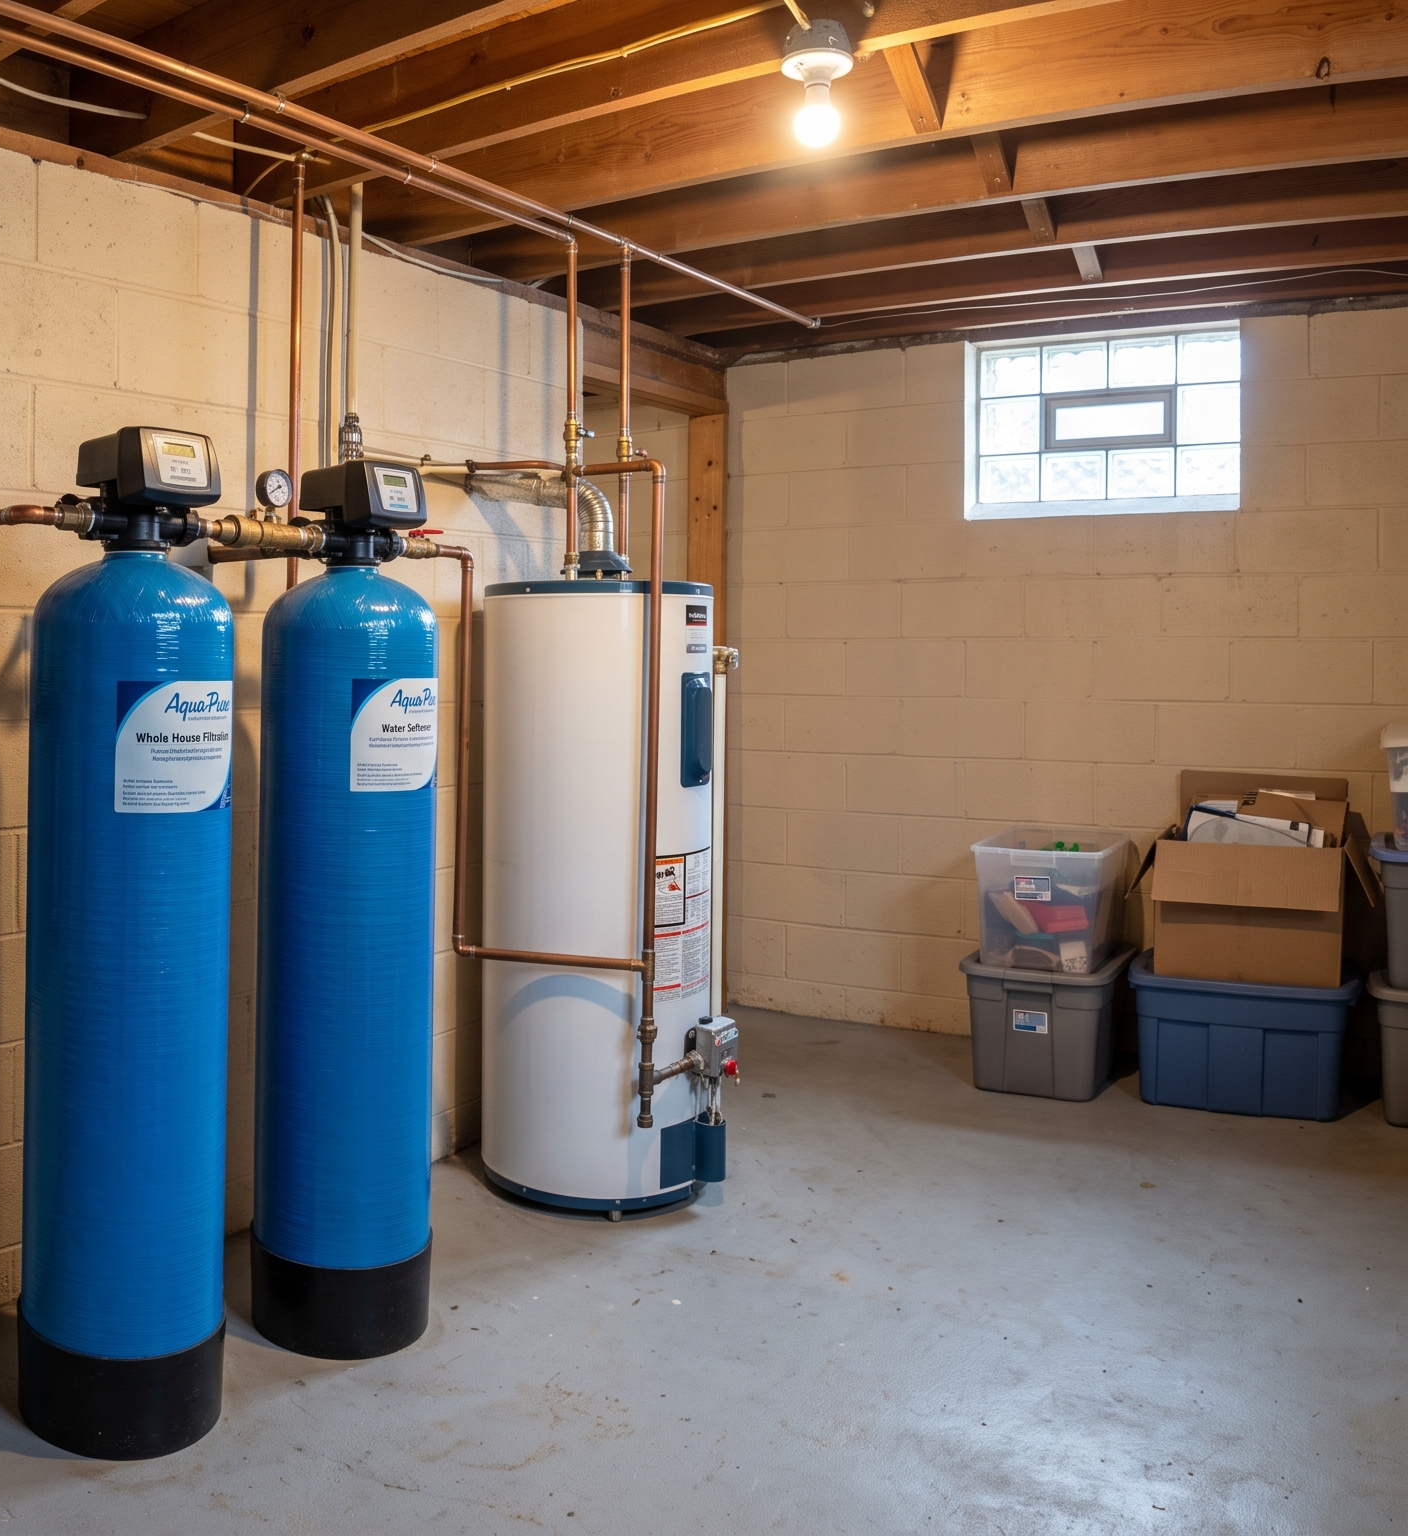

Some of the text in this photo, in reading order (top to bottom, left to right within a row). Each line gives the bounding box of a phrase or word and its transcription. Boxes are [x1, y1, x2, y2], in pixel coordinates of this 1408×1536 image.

[381, 723, 406, 733] Water
[135, 732, 169, 743] Whole
[172, 732, 201, 743] House
